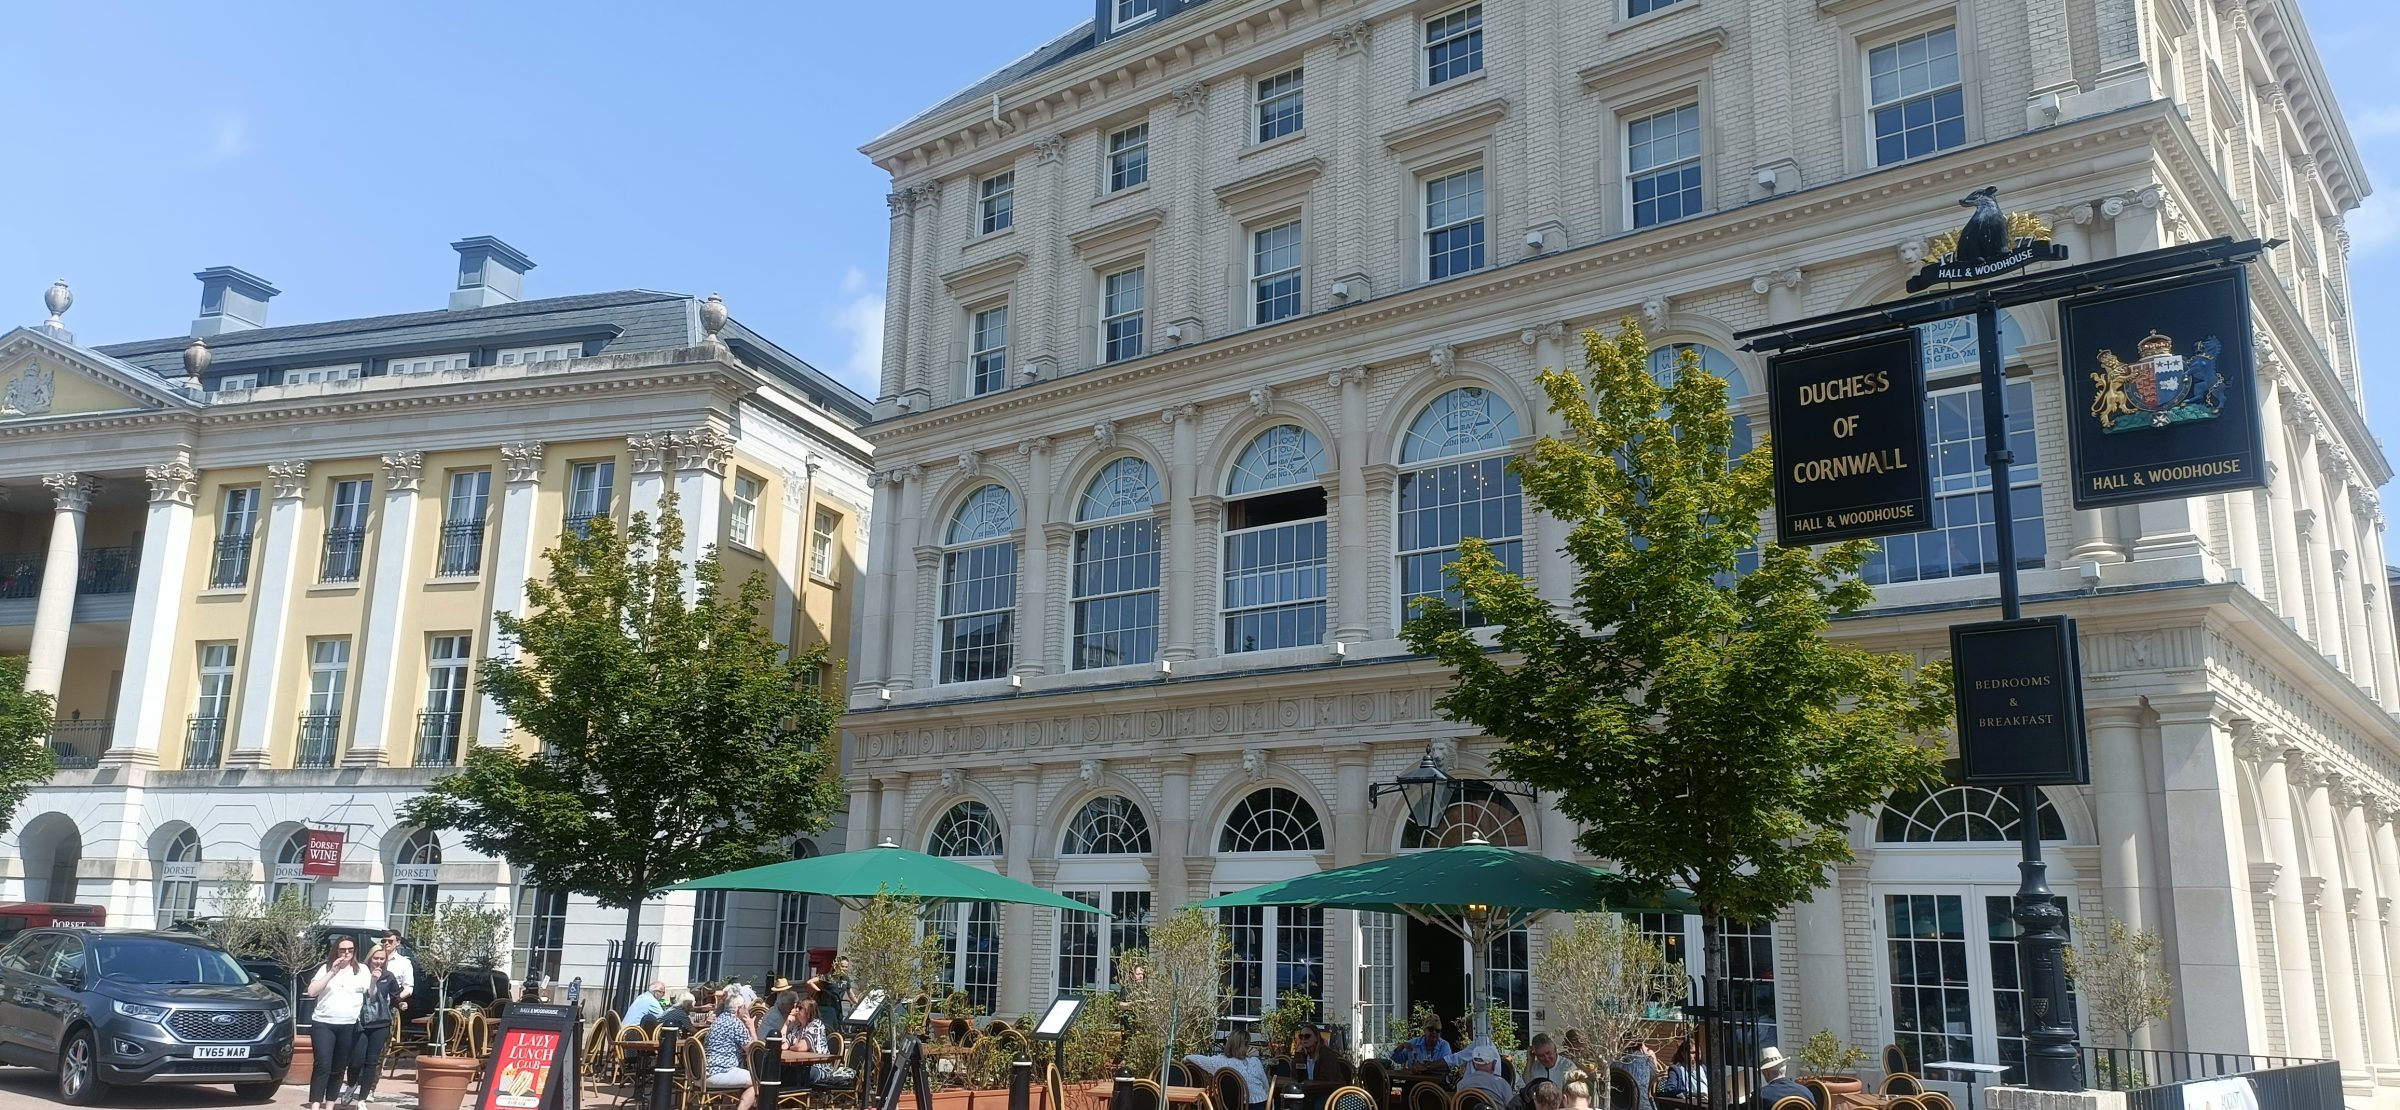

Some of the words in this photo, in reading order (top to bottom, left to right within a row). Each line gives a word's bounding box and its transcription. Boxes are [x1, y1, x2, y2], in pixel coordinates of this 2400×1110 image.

[1939, 251, 1955, 267] 17
[2014, 236, 2034, 248] 77
[1938, 268, 1963, 279] HALL
[1965, 267, 1973, 278] &
[1975, 249, 2034, 275] WOODHOUSE
[1944, 348, 1977, 361] ROOM
[1799, 370, 1890, 406] DUCHESS
[1833, 415, 1860, 439] OF
[1793, 447, 1908, 484] CORNWALL
[2093, 474, 2129, 490] HALL
[2133, 472, 2145, 486] &
[2148, 459, 2241, 483] WOODHOUSE
[1794, 517, 1823, 532] HALL
[1827, 516, 1837, 529] &
[1839, 505, 1915, 526] WOODHOUSE
[1975, 675, 2051, 690] BEDROOMS
[2009, 697, 2018, 707] &
[1979, 714, 2053, 728] BREAKFAST
[310, 840, 340, 850] DORSET
[310, 849, 338, 861] WINE
[163, 866, 195, 875] DORSET
[275, 867, 304, 877] DORSE
[394, 868, 430, 878] DORSET
[52, 920, 87, 928] DORSET
[518, 1032, 554, 1048] LAZY
[199, 1047, 224, 1057] TV65
[226, 1047, 246, 1057] WAR
[509, 1045, 555, 1061] LUNCH
[516, 1060, 541, 1070] CLUB
